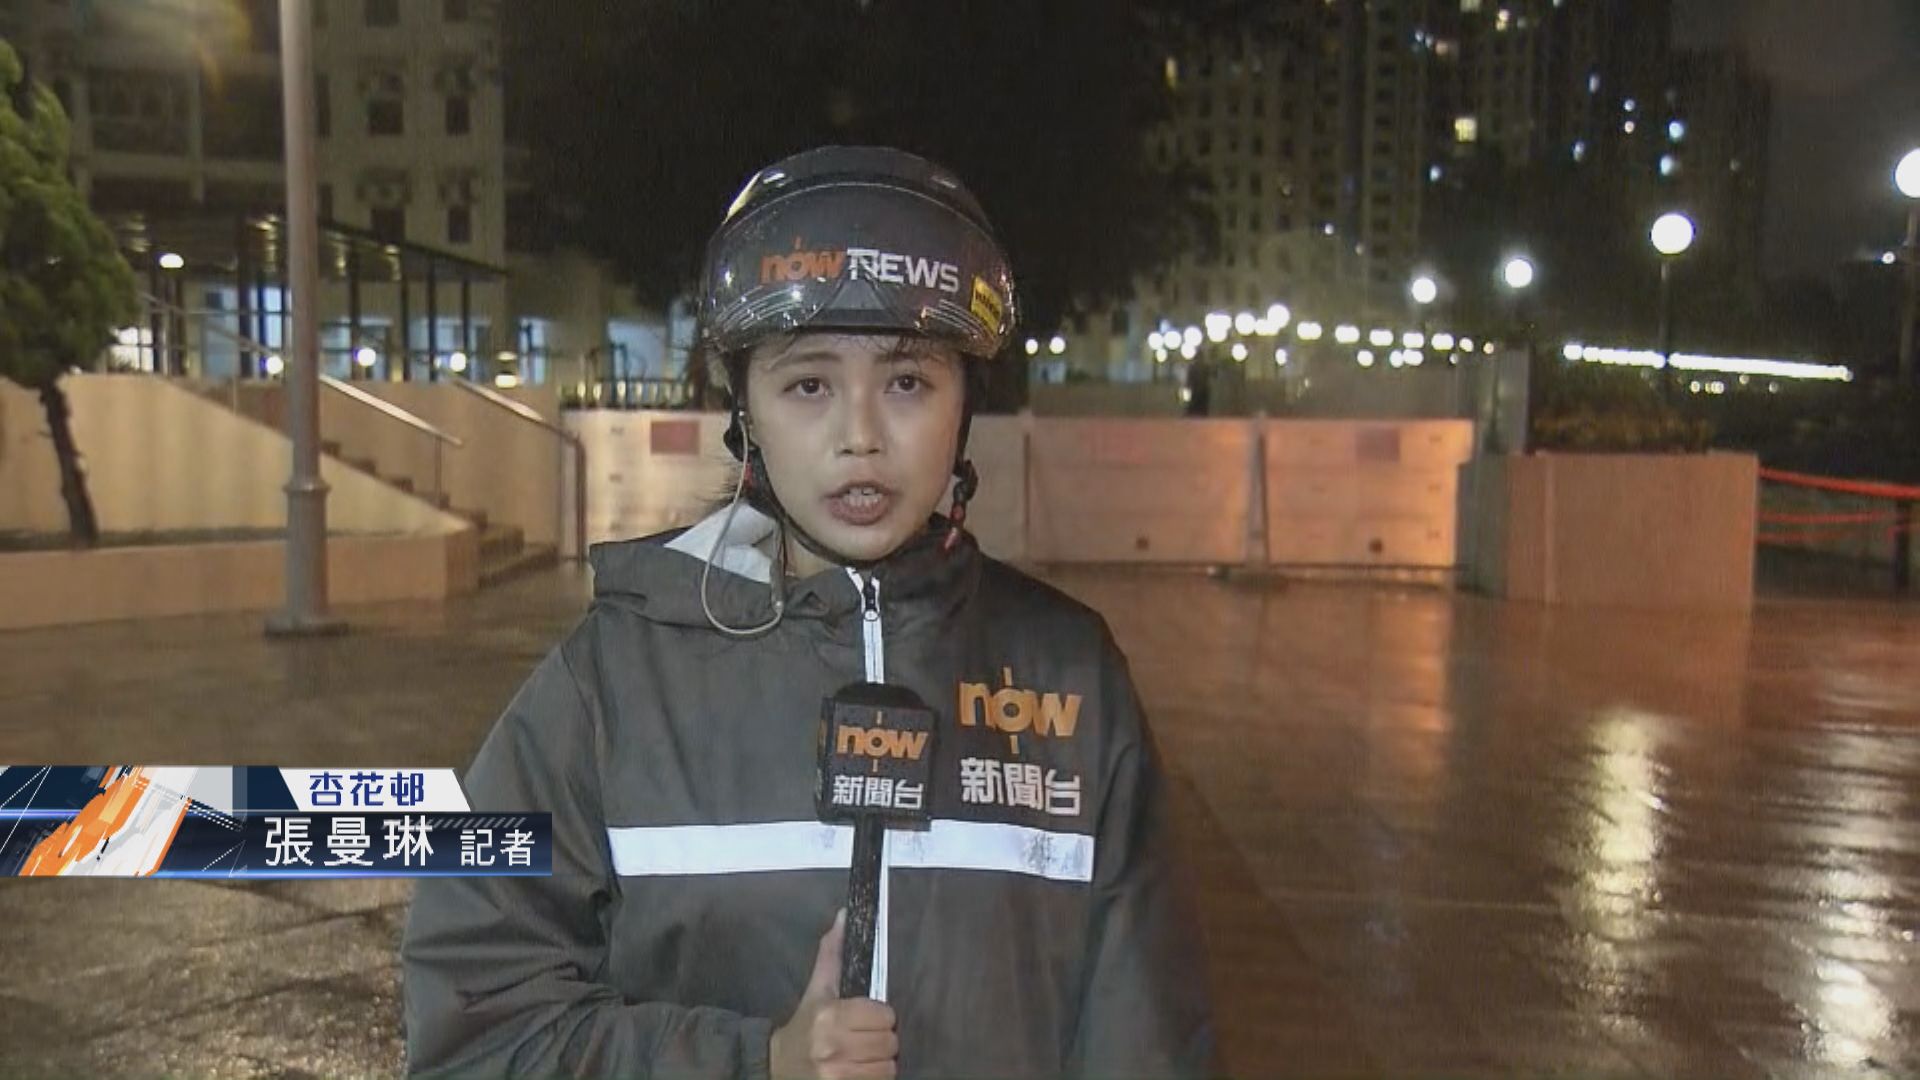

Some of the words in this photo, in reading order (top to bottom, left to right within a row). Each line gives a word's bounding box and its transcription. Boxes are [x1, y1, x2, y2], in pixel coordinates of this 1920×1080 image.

[960, 680, 1082, 737] now
[837, 724, 928, 760] now
[832, 775, 924, 810] 新聞台
[960, 757, 1081, 816] 新聞台
